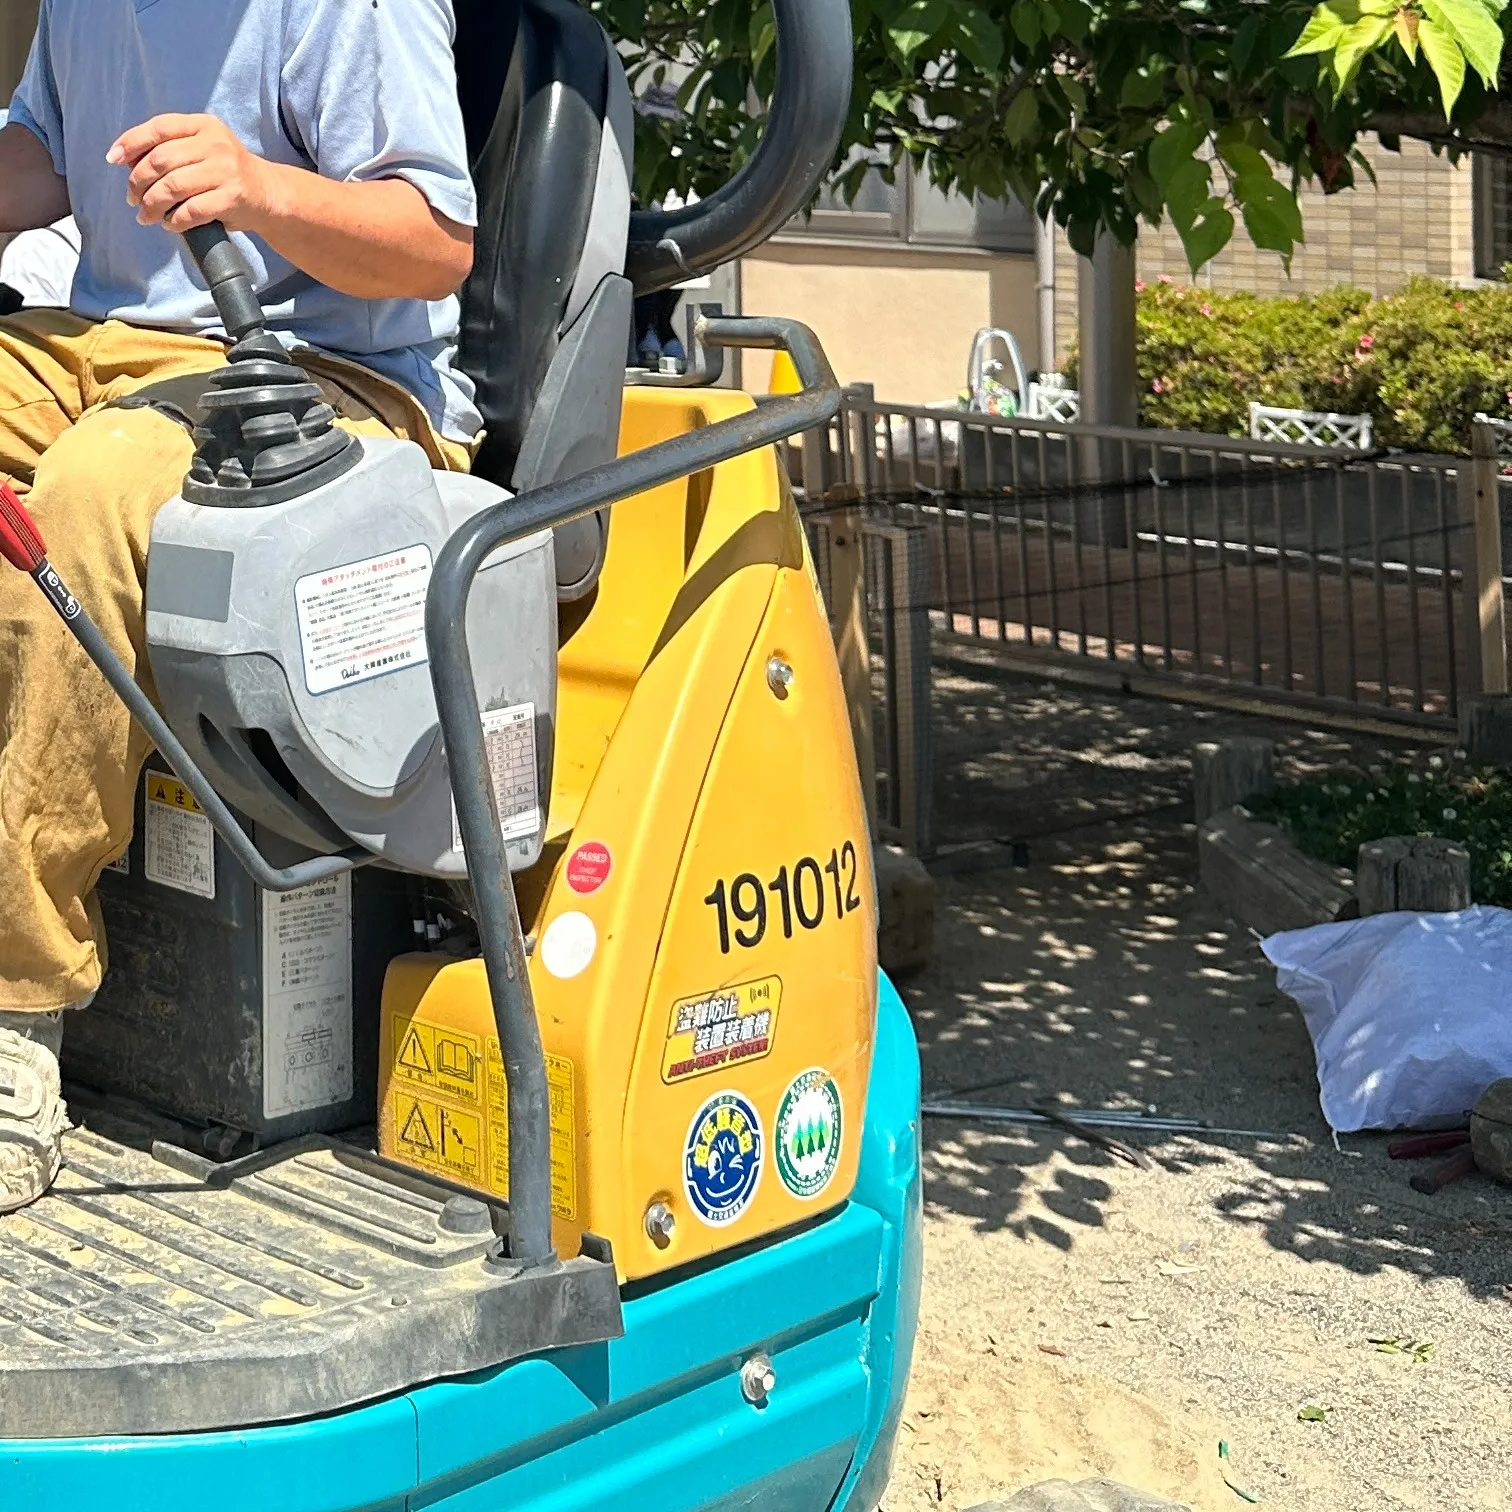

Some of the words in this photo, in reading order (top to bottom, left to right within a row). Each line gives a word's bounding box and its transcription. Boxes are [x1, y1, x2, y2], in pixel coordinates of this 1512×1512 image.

[704, 839, 861, 955] 191012
[676, 994, 738, 1032] 盗難防止
